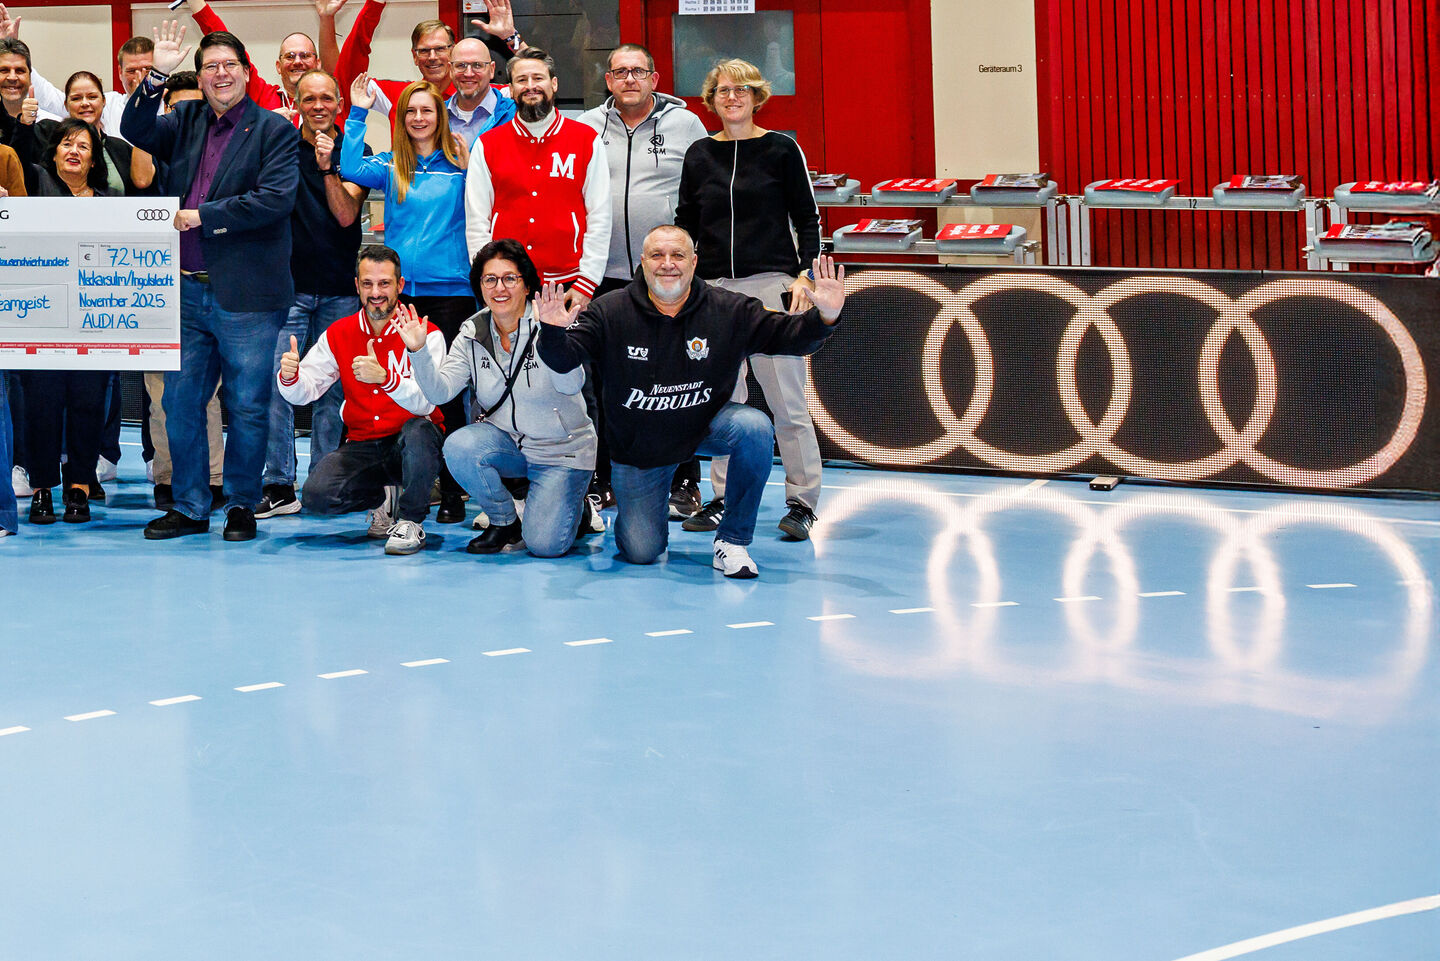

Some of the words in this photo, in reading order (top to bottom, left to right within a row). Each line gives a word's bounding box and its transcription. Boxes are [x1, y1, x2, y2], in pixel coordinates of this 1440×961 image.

[1017, 64, 1023, 73] 3
[549, 152, 576, 180] M
[859, 196, 867, 206] 15
[1188, 199, 1197, 208] 12
[107, 247, 172, 268] 72.400€
[79, 292, 129, 307] November
[130, 292, 166, 308] 2025
[82, 312, 114, 329] AUDI
[116, 313, 139, 329] AG
[388, 348, 411, 376] M
[649, 381, 704, 395] NEUENSTADT
[622, 387, 712, 411] PITBULLS
